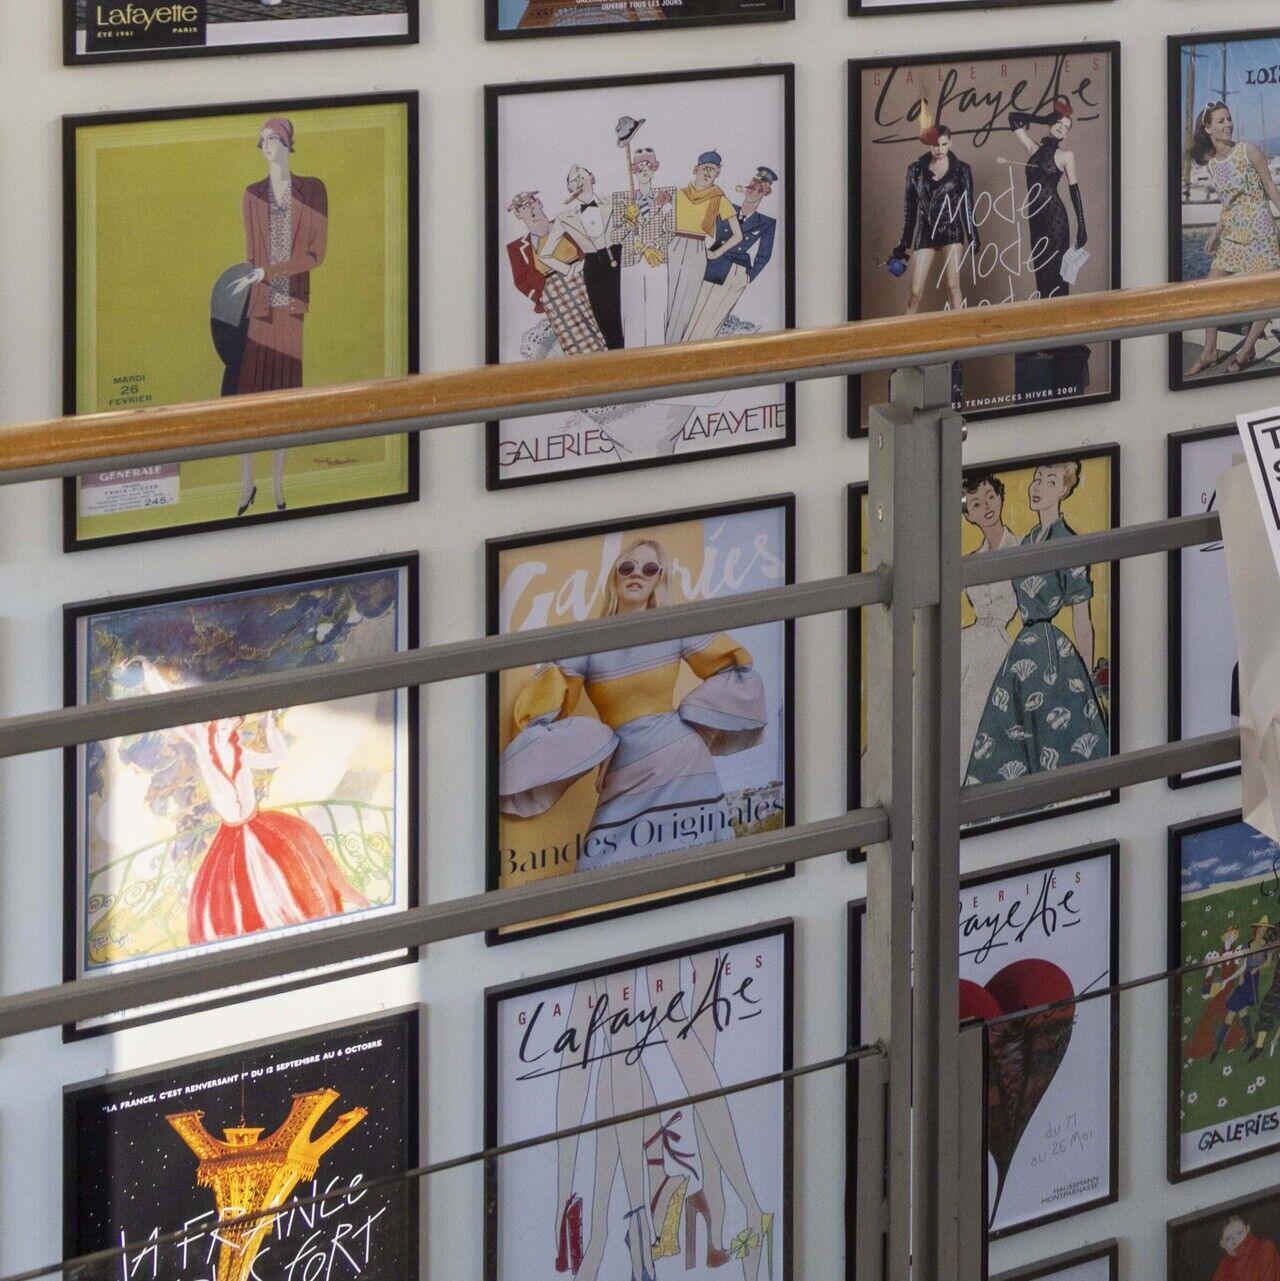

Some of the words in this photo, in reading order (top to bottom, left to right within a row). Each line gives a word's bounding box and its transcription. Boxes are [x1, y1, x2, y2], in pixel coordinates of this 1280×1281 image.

[96, 3, 199, 31] Lafayette
[601, 1, 627, 11] OUVERT
[629, 0, 647, 9] TOUS
[648, 0, 661, 8] LES
[172, 26, 198, 34] PARIS
[872, 57, 1100, 87] GALERIES
[873, 53, 1102, 146] Lafayette
[931, 165, 1053, 240] Mode
[936, 222, 1060, 288] Mode
[112, 374, 147, 385] MARDI
[120, 385, 140, 396] 26
[965, 394, 1021, 407] TENDANCES
[1024, 390, 1053, 400] HIVER
[1057, 387, 1077, 397] 2001
[681, 403, 786, 443] LAFAYETTE
[500, 426, 615, 467] GALERIES
[501, 522, 784, 628] Galries
[500, 831, 619, 878] Bandes
[629, 794, 785, 850] Originales
[518, 955, 764, 1027] GALERIES
[518, 952, 763, 1069] Lafayette
[120, 1093, 157, 1109] FRANCE,
[159, 1086, 182, 1100] C'EST
[185, 1074, 240, 1095] RENVERSANT
[251, 1068, 264, 1079] DU
[276, 1054, 321, 1073] SEPTEMBRE
[323, 1050, 336, 1062] AU
[345, 1039, 383, 1056] OCTOBRE
[1196, 1110, 1280, 1152] GALERIES
[1041, 1182, 1099, 1205] MONTPARNASSE
[1052, 1175, 1099, 1195] HAUSSMANN
